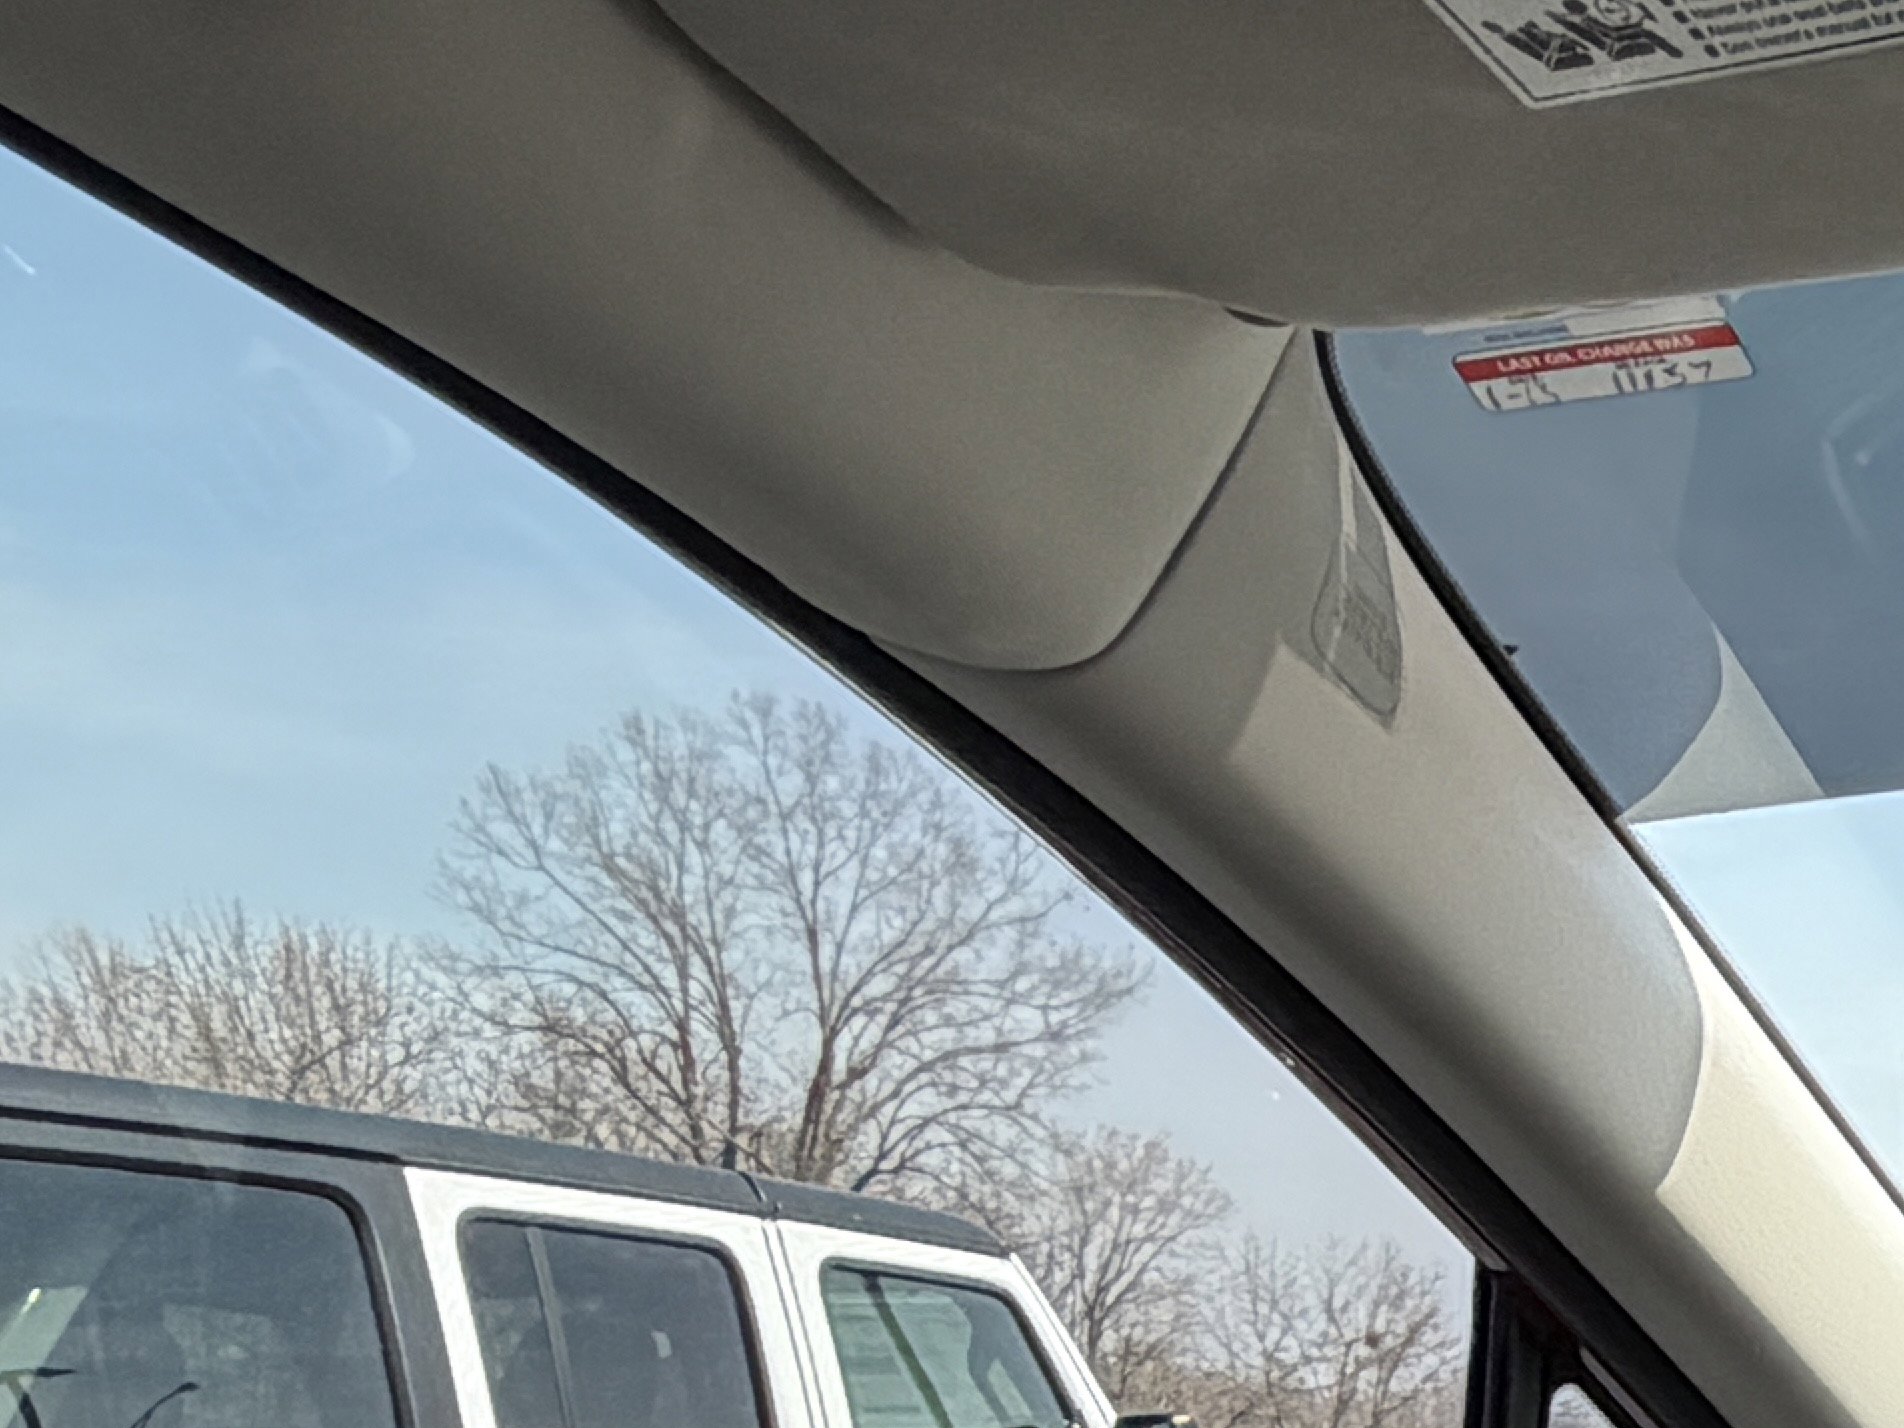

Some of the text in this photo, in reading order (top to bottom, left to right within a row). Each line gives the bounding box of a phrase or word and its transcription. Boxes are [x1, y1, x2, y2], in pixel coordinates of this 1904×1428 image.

[1496, 354, 1544, 372] LAST
[1576, 340, 1653, 361] CHANGE
[1652, 333, 1697, 352] WAS
